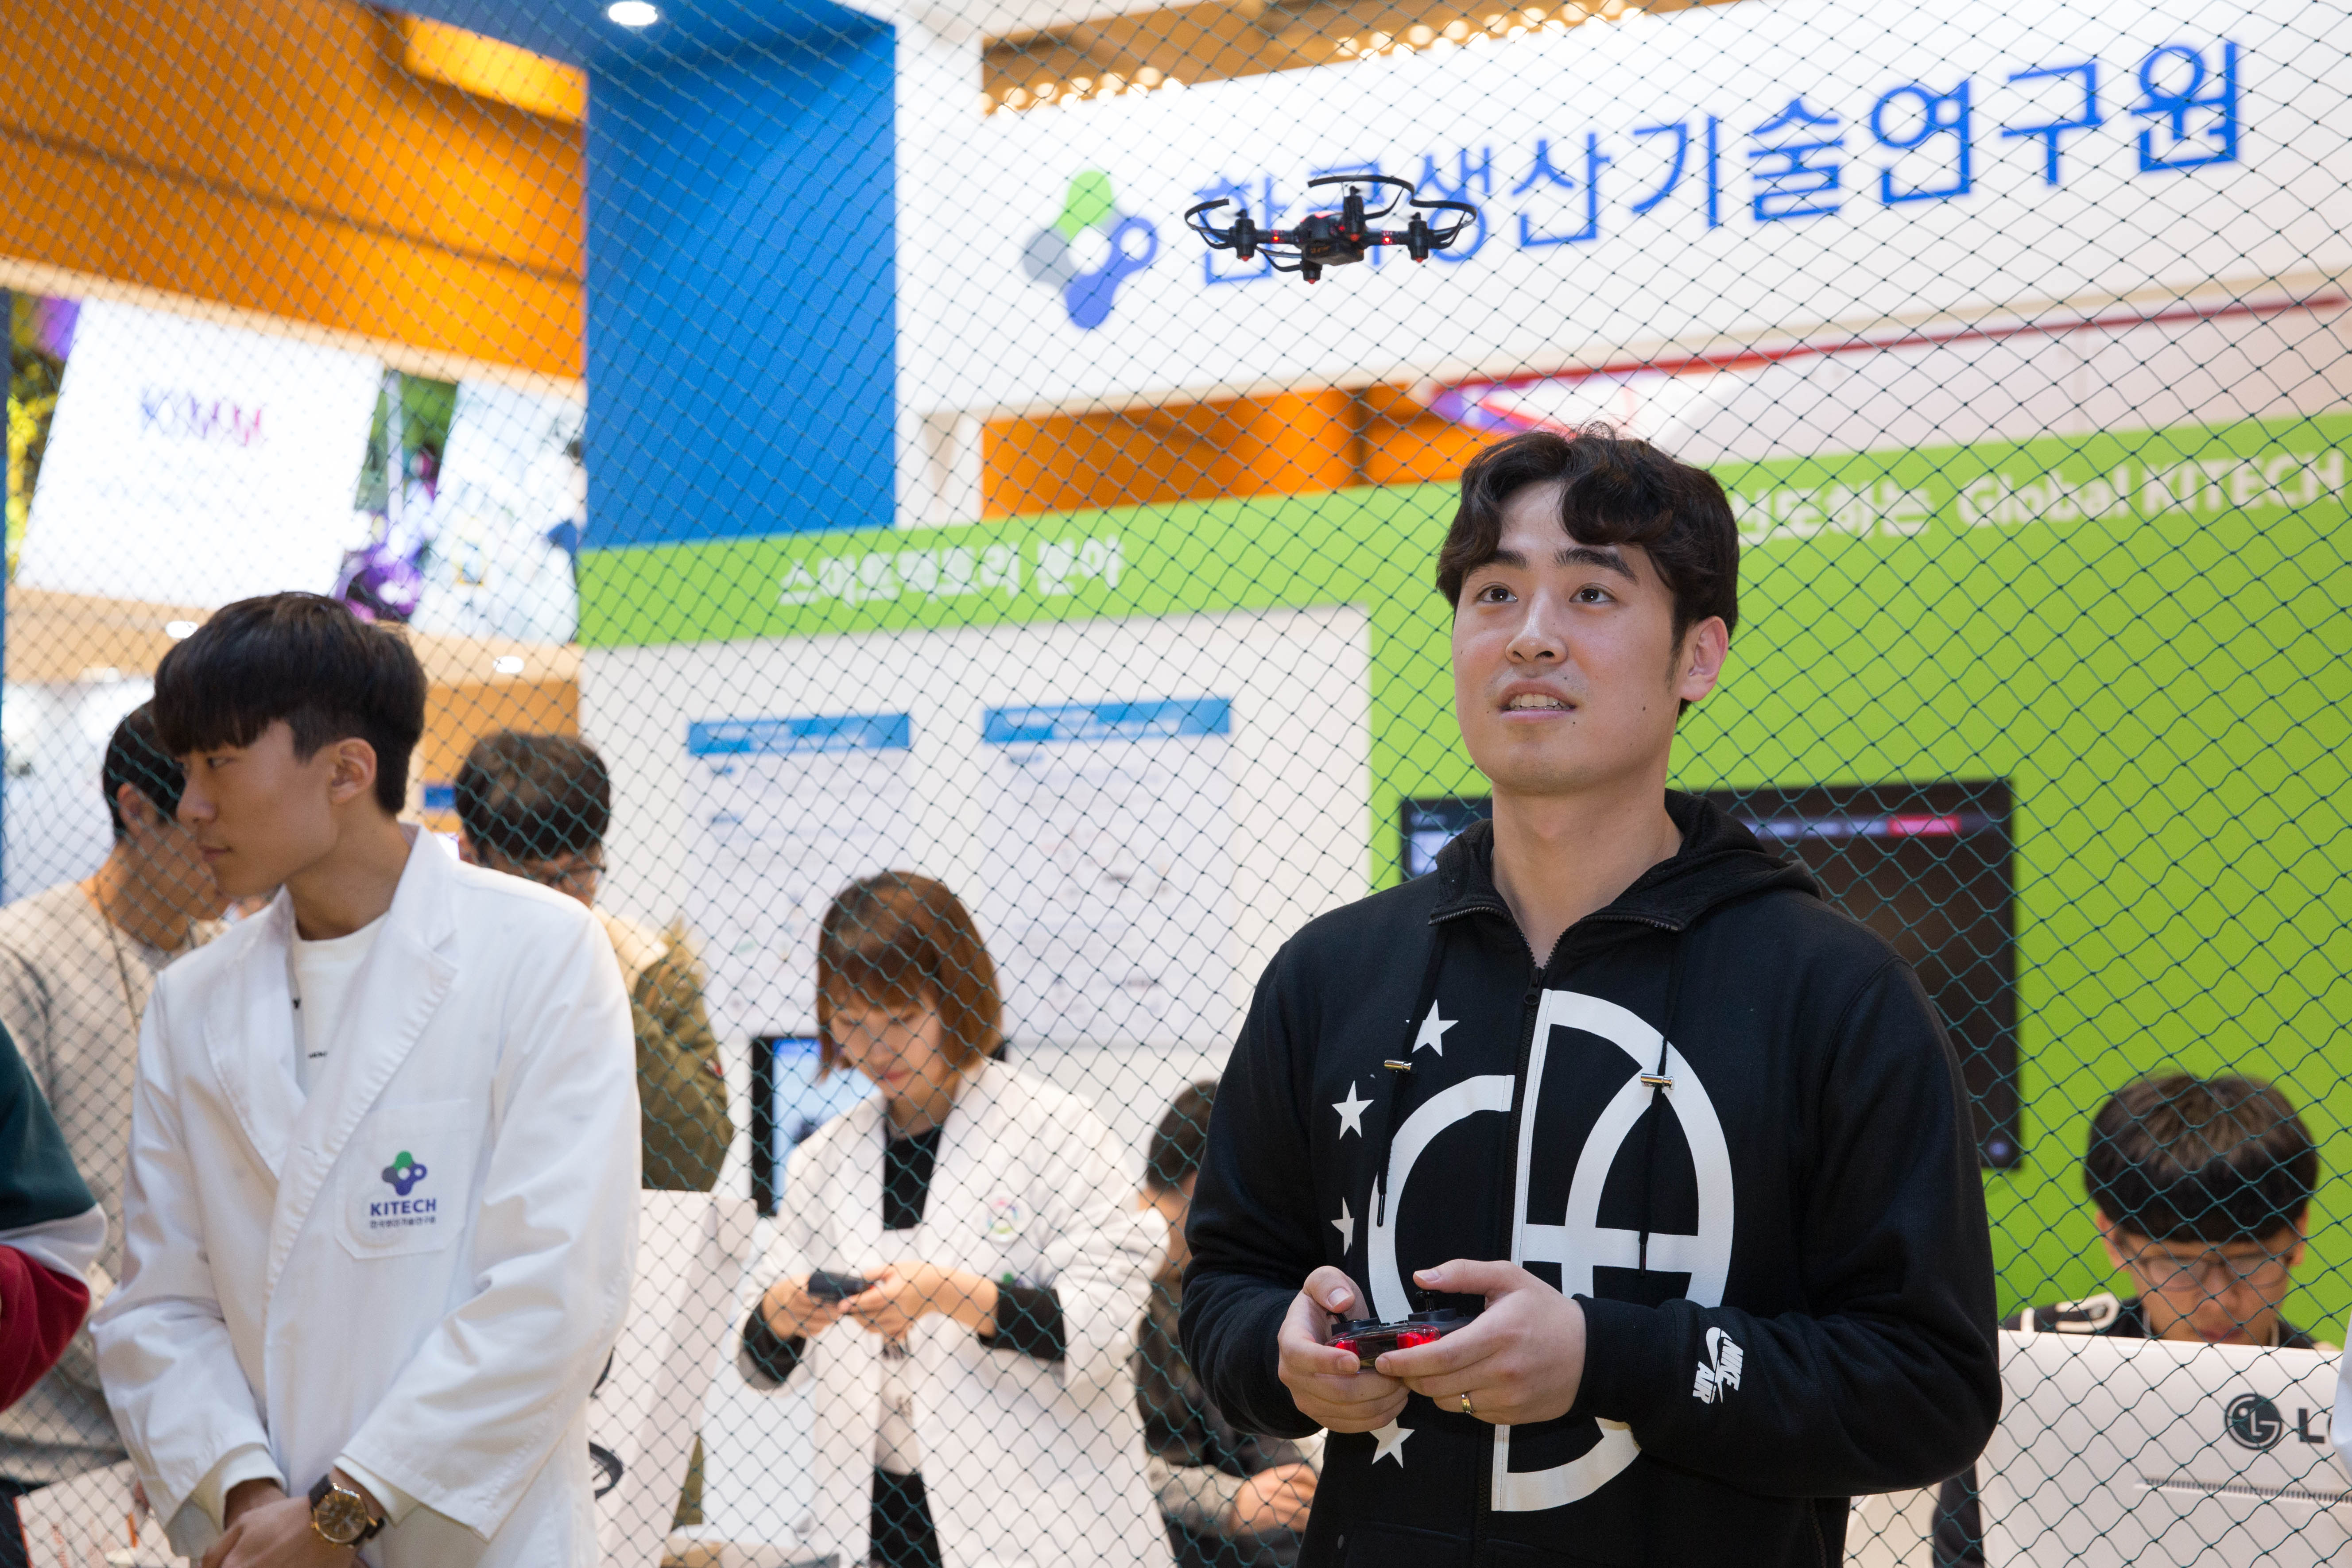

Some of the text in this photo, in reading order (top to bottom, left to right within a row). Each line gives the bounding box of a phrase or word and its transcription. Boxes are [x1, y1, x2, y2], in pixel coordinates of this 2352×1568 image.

[1957, 464, 2129, 527] Global
[2141, 449, 2344, 515] KITECH
[370, 1197, 436, 1216] KITECH
[1693, 1361, 1717, 1404] AIR
[1717, 1338, 1744, 1391] NIKE
